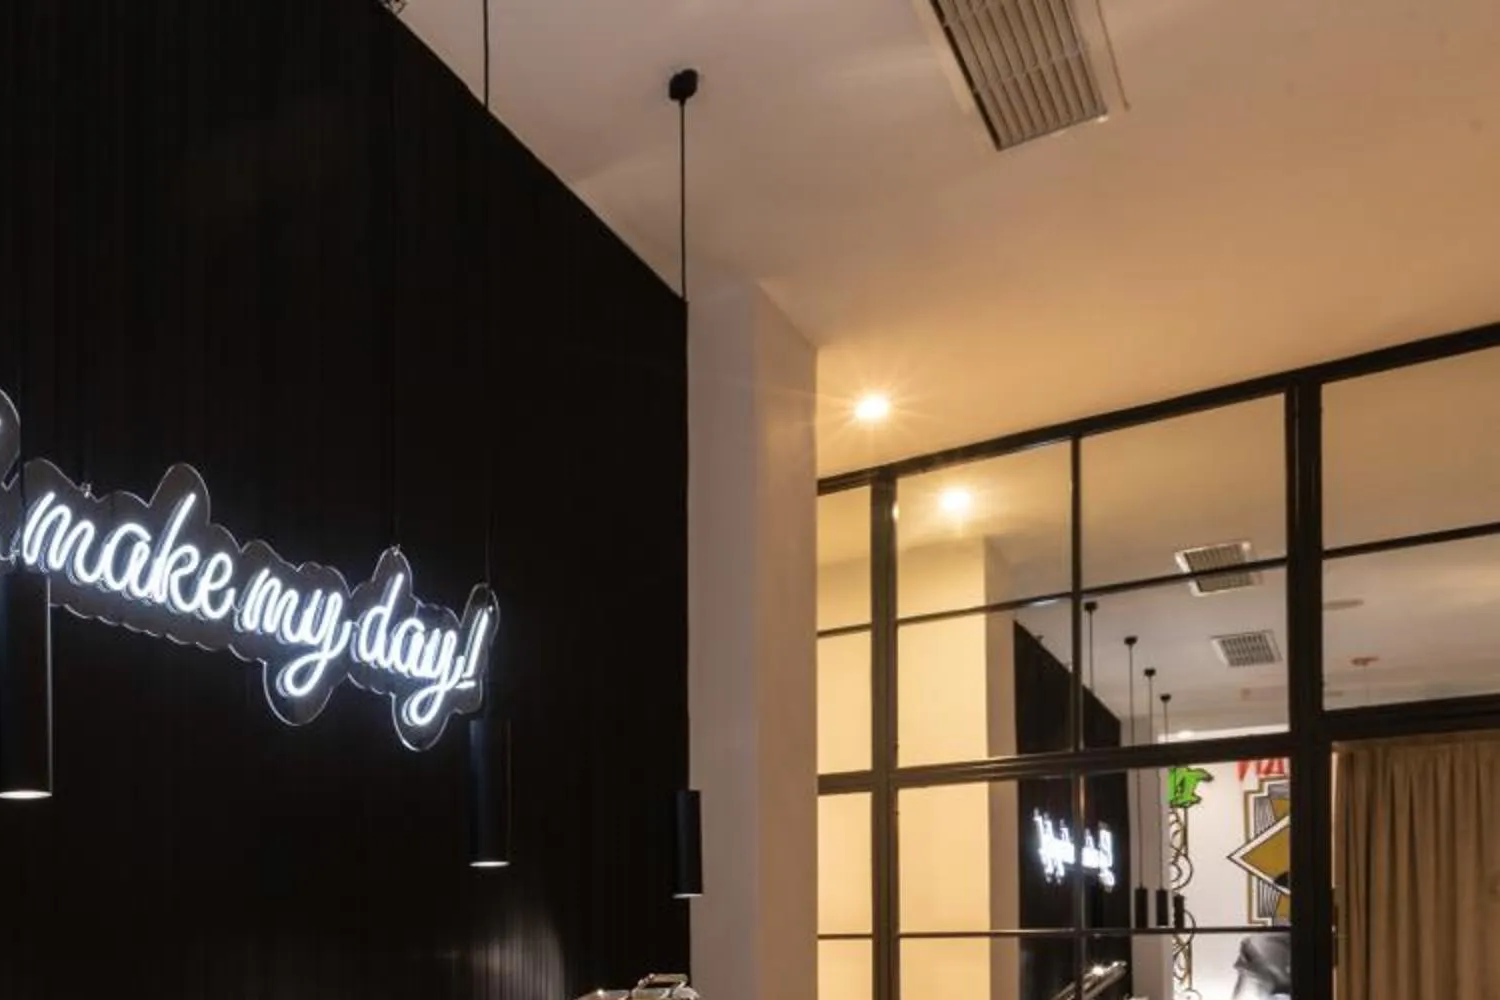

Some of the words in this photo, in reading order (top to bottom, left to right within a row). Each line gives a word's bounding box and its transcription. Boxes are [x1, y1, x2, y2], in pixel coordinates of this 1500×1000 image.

[20, 489, 238, 621] make
[240, 566, 353, 699] my
[355, 570, 493, 729] day!
